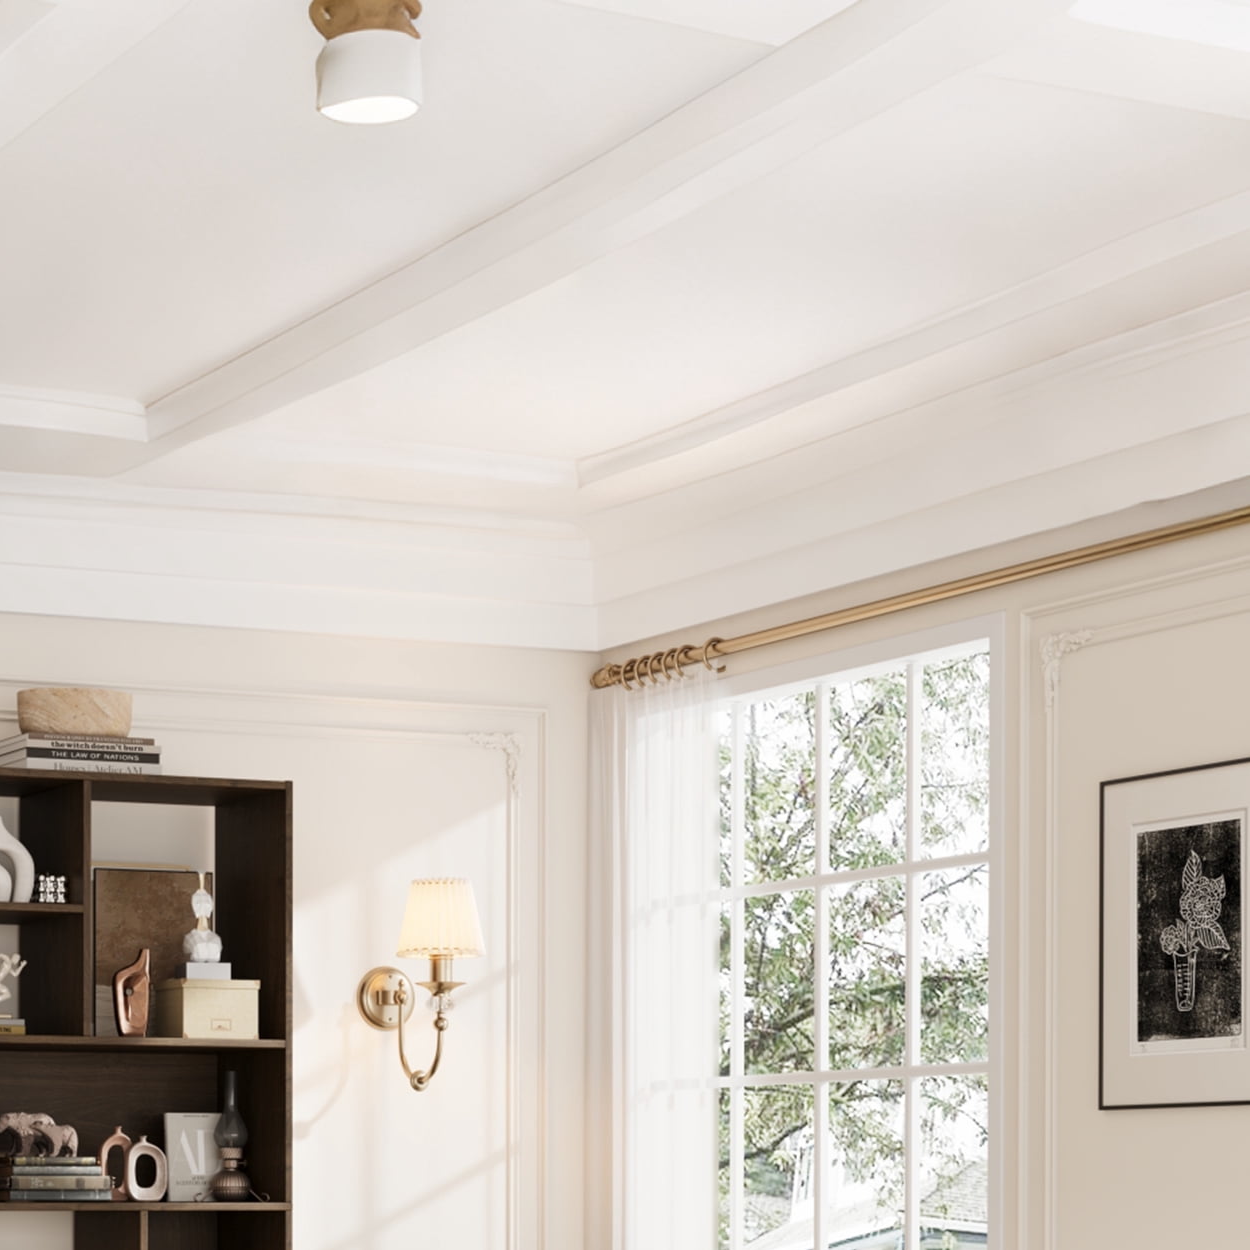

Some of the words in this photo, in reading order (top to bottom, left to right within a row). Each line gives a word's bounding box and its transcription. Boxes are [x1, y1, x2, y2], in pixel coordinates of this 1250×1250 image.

[67, 741, 90, 749] witch
[91, 742, 122, 751] doesn't
[123, 744, 143, 752] burn
[51, 750, 67, 758] THE
[70, 751, 88, 759] LAW
[104, 753, 139, 761] NATIONS
